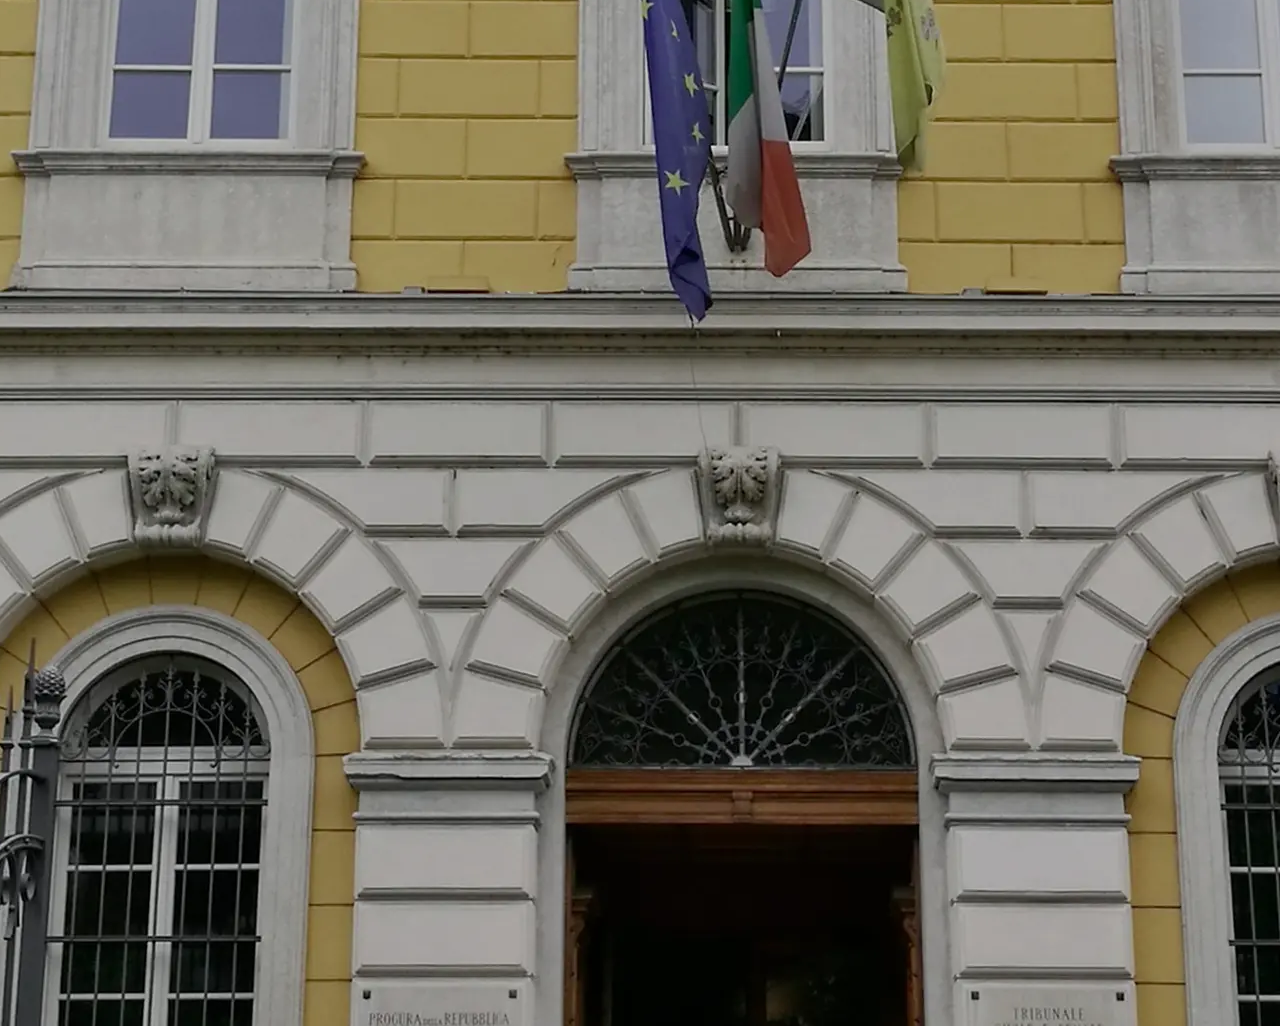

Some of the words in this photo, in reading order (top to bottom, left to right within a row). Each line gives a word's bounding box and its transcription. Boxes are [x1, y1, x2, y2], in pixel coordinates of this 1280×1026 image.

[369, 1012, 421, 1026] PROCURA
[444, 1012, 510, 1026] REPUBBLICA
[1013, 1007, 1085, 1021] TRIBUNALE
